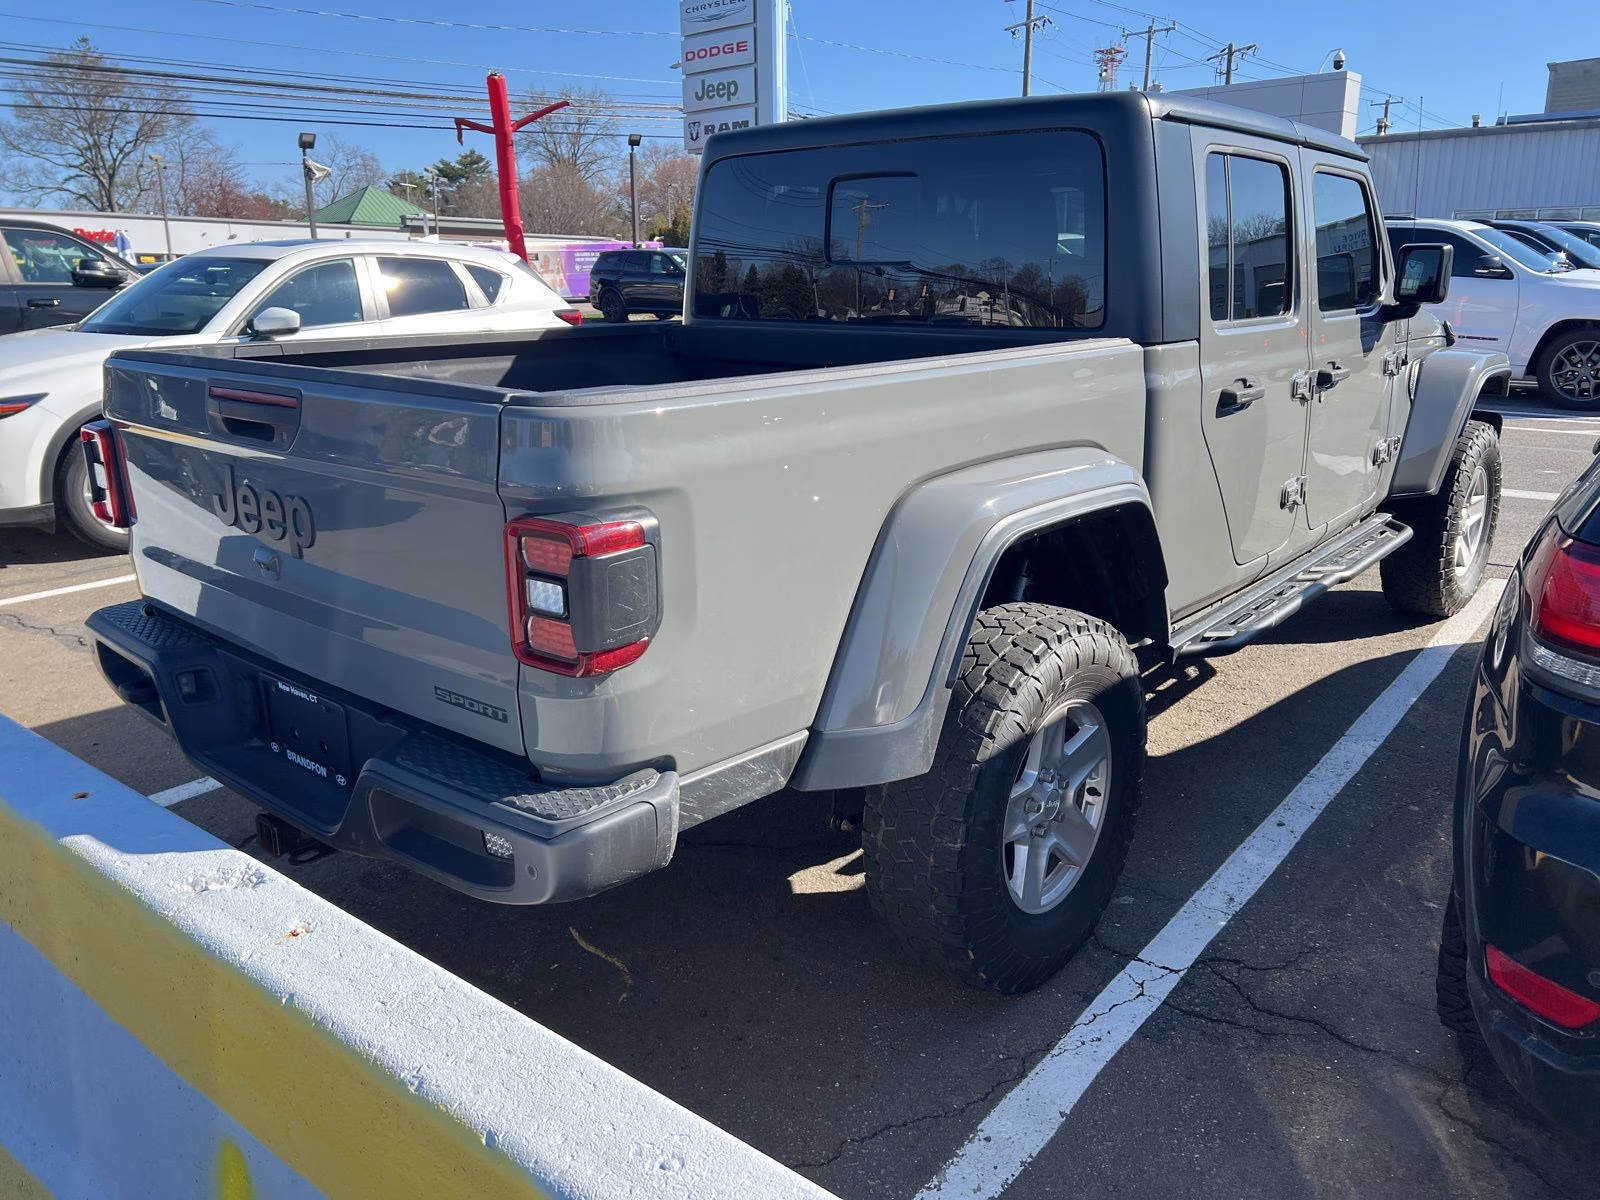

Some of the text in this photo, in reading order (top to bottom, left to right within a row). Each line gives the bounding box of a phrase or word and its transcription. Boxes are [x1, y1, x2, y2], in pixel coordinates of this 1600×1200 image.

[685, 40, 748, 62] DODGE
[694, 79, 739, 102] Jeep
[703, 119, 749, 135] RAM
[212, 463, 316, 560] Jeep
[278, 681, 290, 692] New
[434, 686, 508, 724] SPORT
[286, 749, 327, 777] BRANDFON
